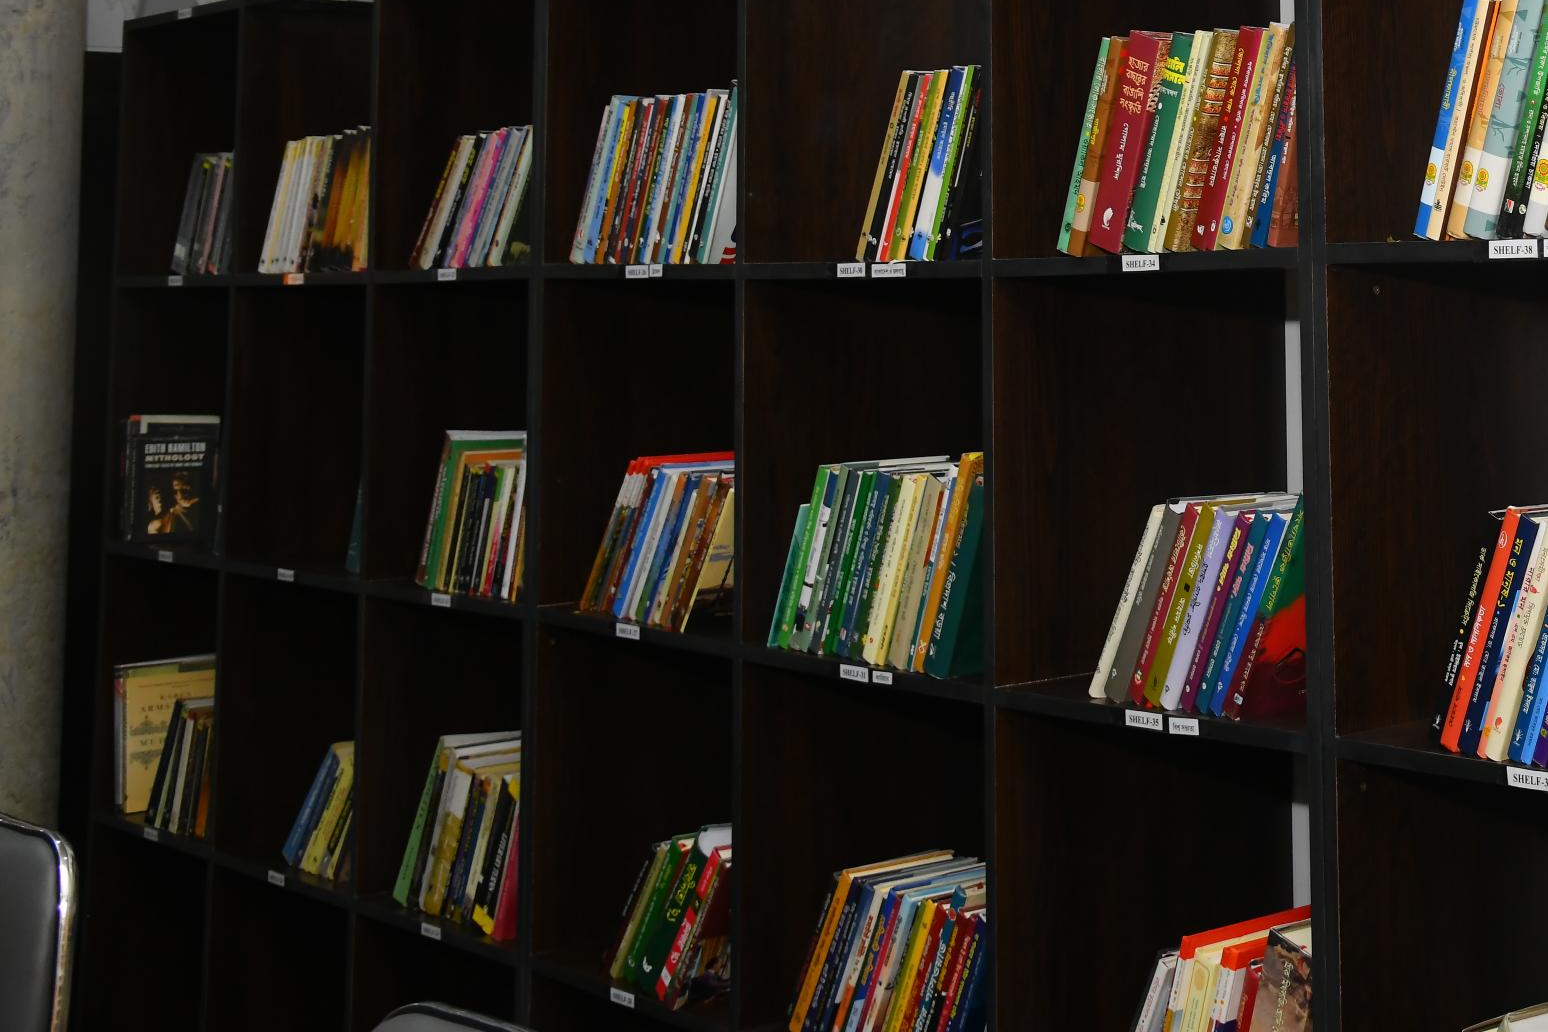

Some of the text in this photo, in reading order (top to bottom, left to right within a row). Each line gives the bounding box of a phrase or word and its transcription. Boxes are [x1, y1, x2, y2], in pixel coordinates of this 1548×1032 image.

[1493, 245, 1533, 255] SHELF-38
[1125, 259, 1156, 270] SHELF-34
[144, 452, 206, 462] MYTHOLOGY
